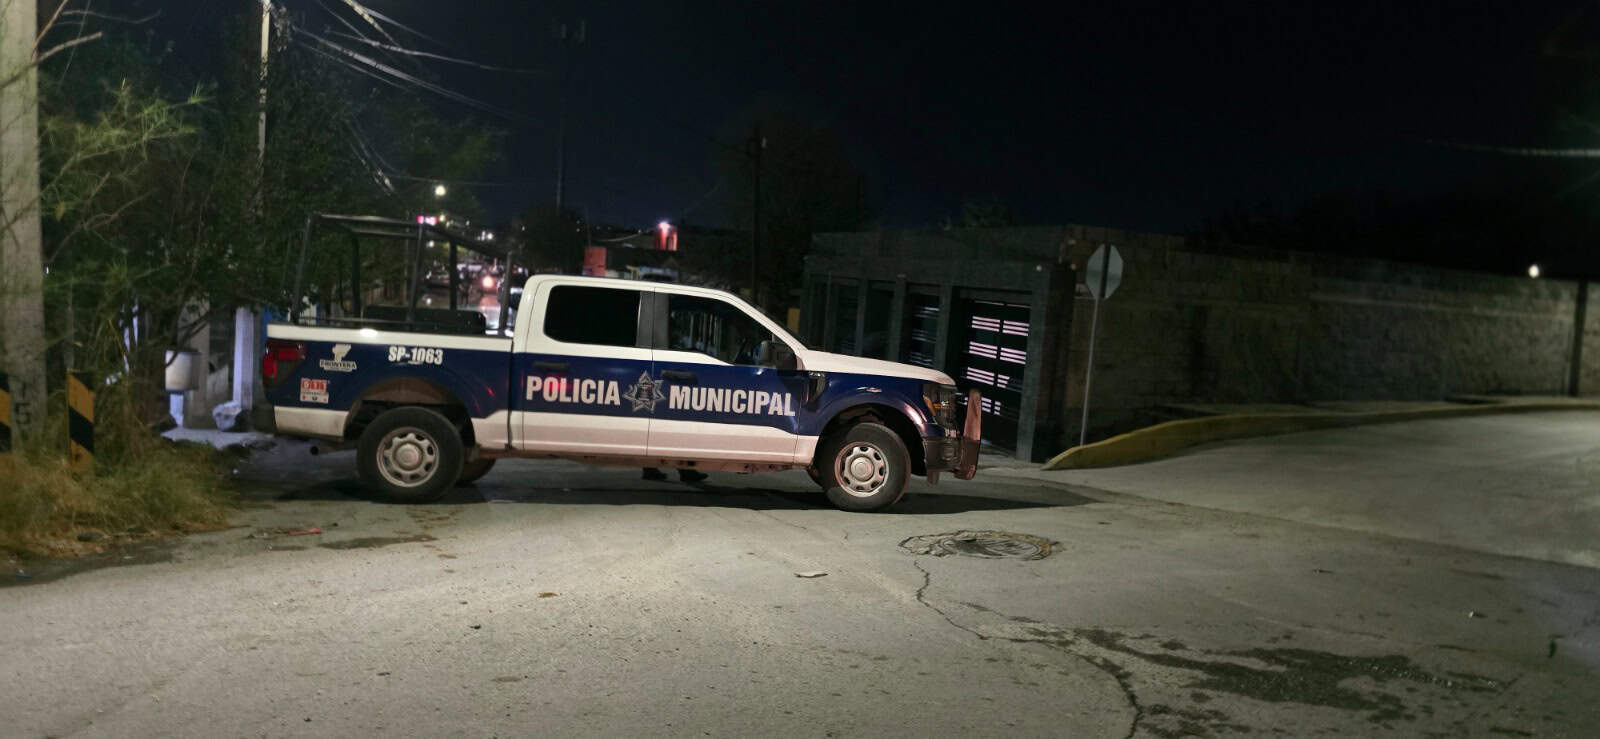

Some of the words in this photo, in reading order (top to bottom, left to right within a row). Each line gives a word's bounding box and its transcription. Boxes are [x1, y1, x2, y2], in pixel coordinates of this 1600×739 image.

[388, 346, 443, 365] SP-1063
[525, 375, 621, 406] POLICIA
[668, 384, 796, 417] MUNICIPAL
